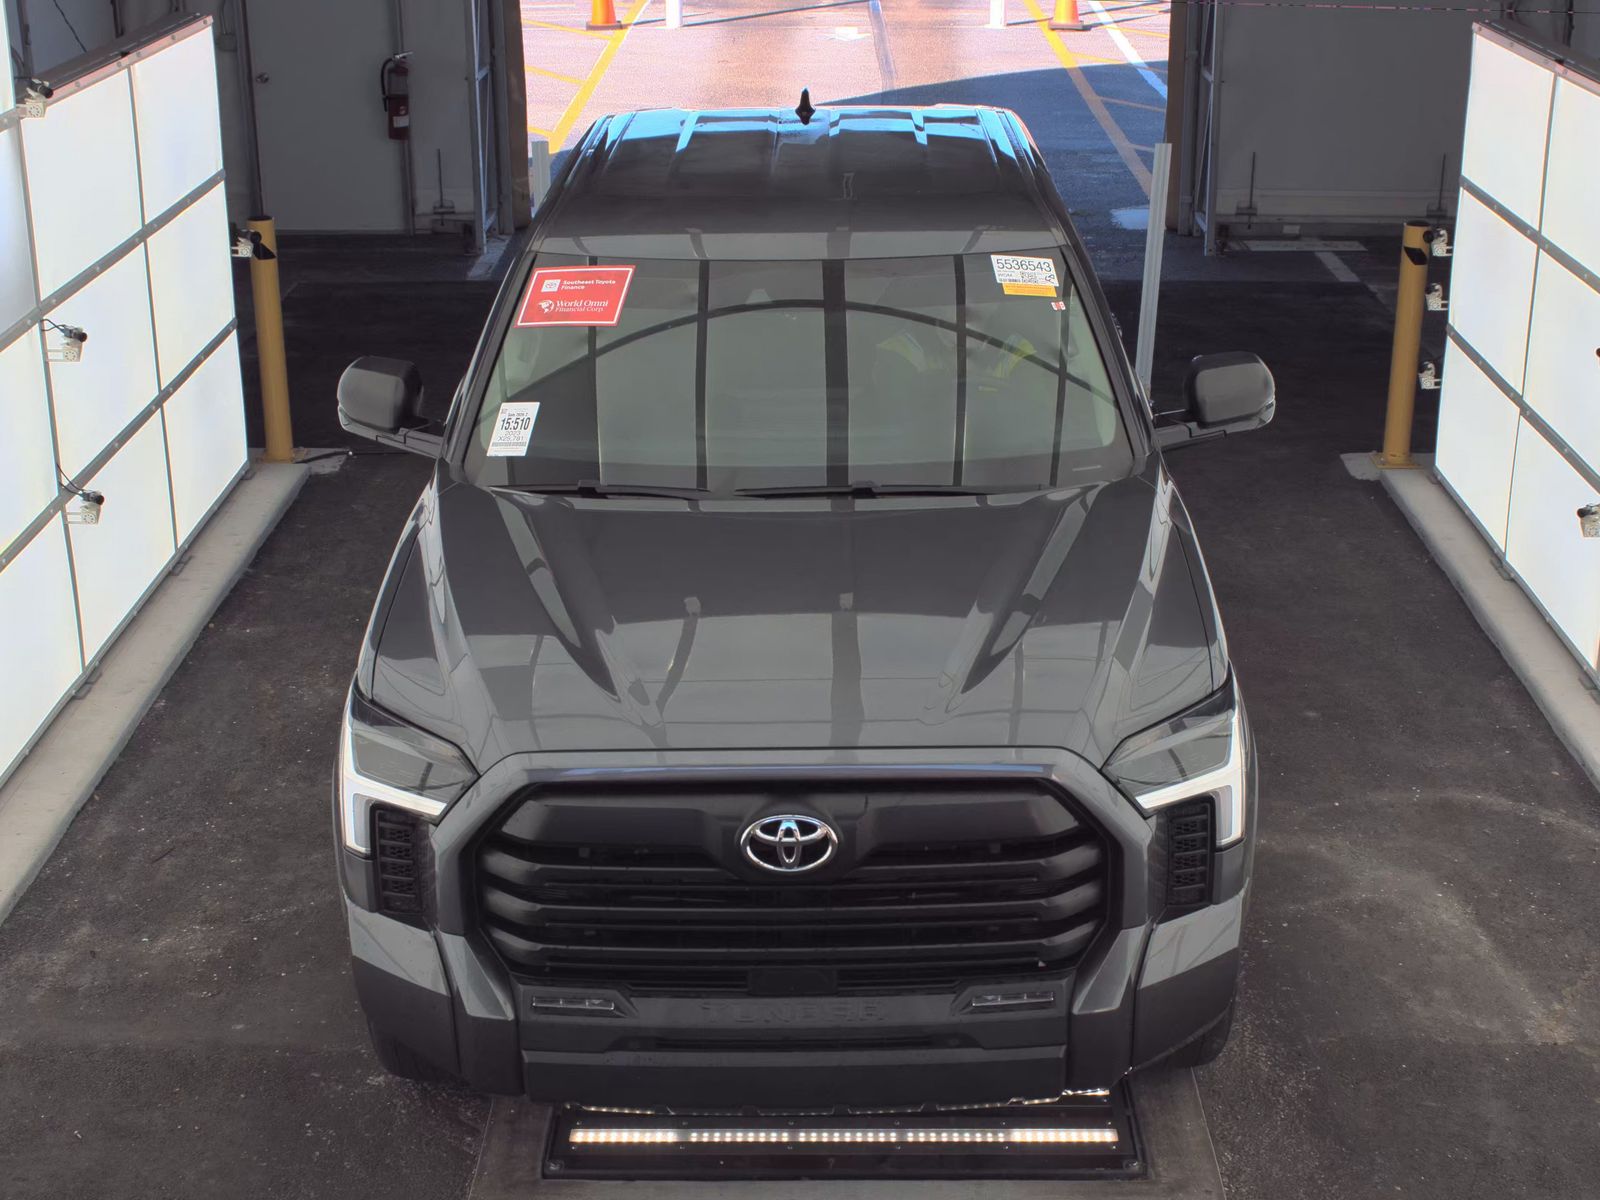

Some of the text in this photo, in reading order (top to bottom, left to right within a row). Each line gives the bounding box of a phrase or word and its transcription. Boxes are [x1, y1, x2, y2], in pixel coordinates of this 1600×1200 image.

[996, 258, 1052, 272] 5536543
[556, 299, 609, 307] World Omni
[500, 416, 531, 430] 15:510
